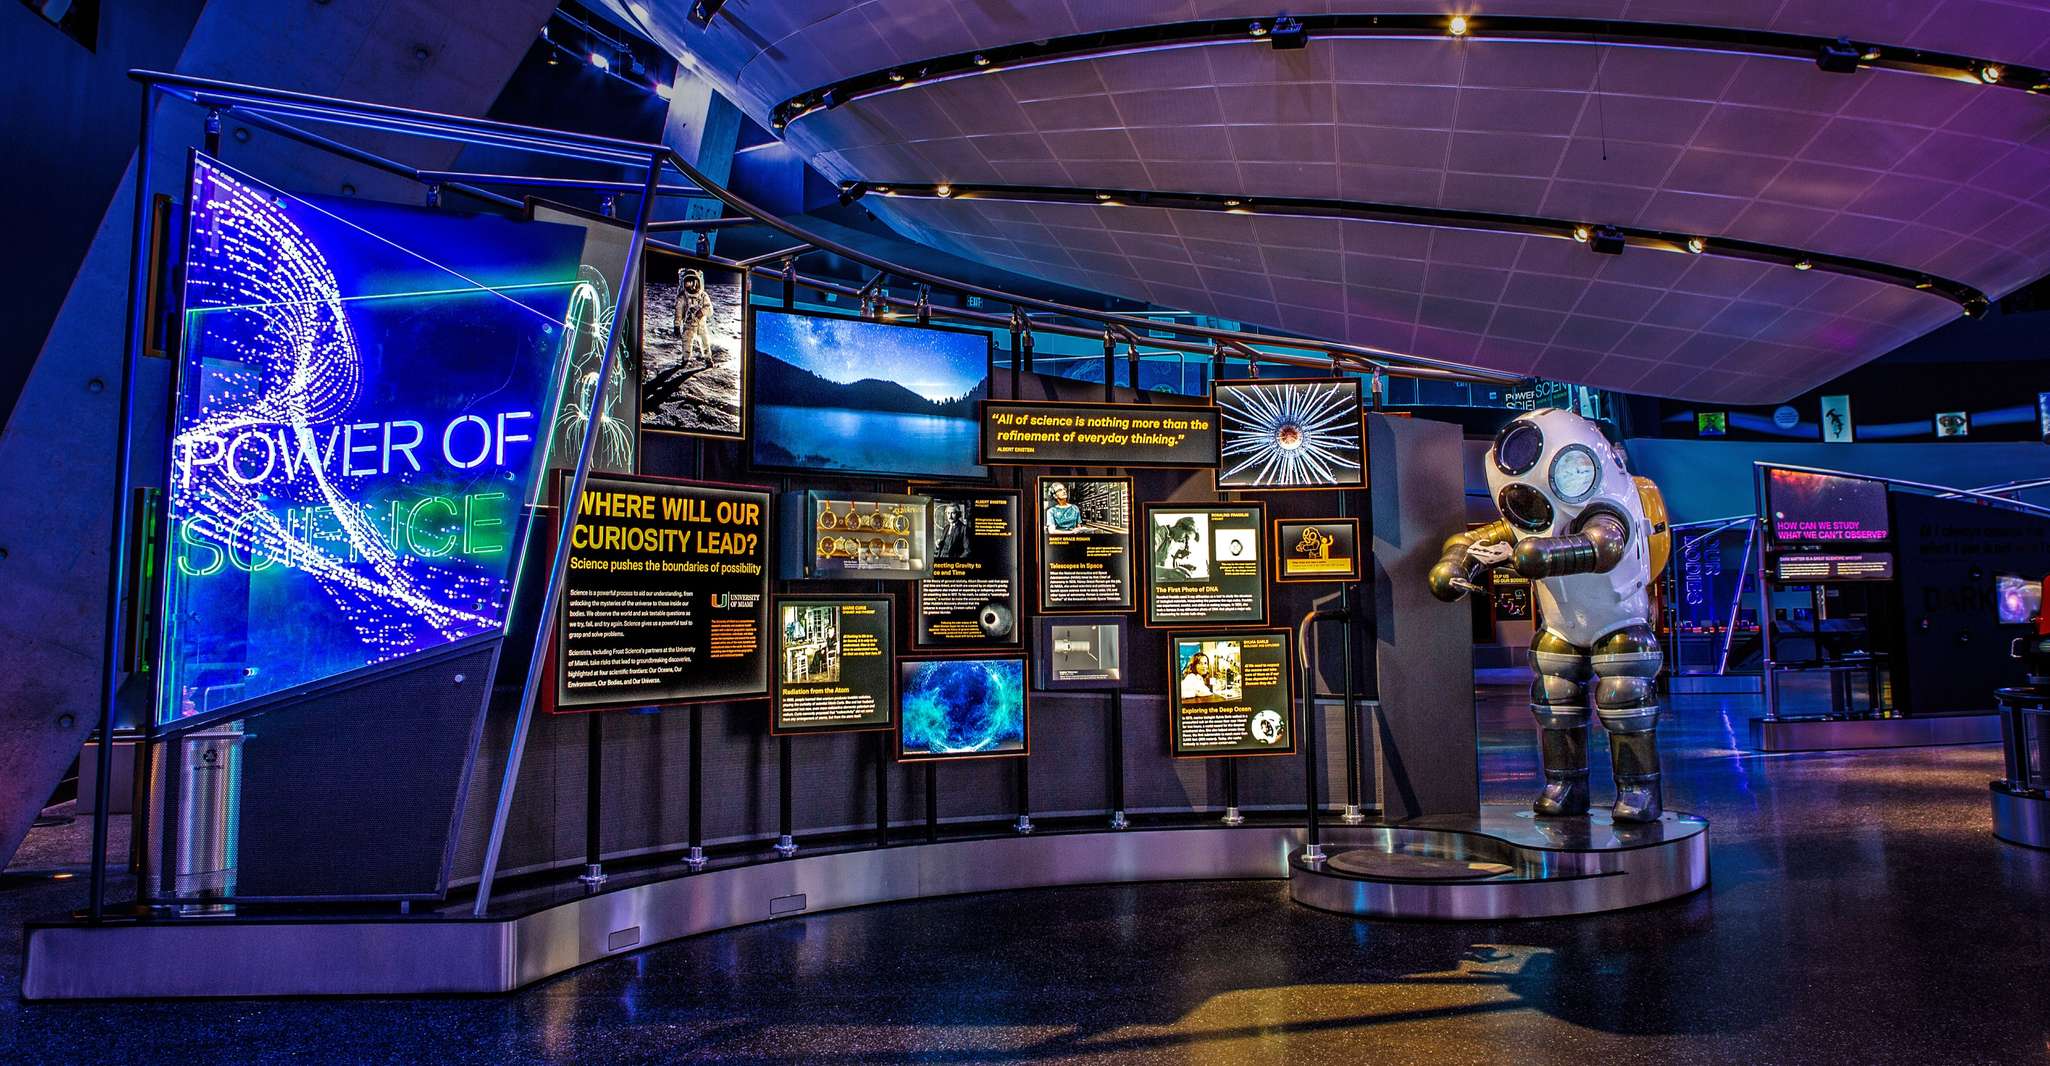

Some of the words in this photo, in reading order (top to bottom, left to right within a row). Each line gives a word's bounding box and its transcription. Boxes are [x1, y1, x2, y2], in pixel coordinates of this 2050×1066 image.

[1536, 381, 1567, 398] SCIEN
[1015, 414, 1028, 425] of
[1030, 414, 1072, 426] science
[1075, 416, 1085, 427] is
[1088, 416, 1129, 430] nothing
[1132, 420, 1160, 429] more
[1162, 418, 1188, 430] than
[1190, 419, 1208, 430] the
[997, 430, 1060, 442] refinement
[1062, 431, 1075, 442] of
[1078, 433, 1128, 445] everyday
[179, 420, 424, 488] POWER
[442, 410, 532, 469] OF
[578, 490, 655, 520] WHERE
[662, 496, 711, 523] WILL
[716, 501, 760, 526] OUR
[178, 493, 504, 576] SCIENCE
[1777, 521, 1797, 530] HOW
[1800, 521, 1816, 529] CAN
[1818, 521, 1832, 529] WE
[1833, 521, 1860, 529] STUDY
[572, 524, 691, 553] CURIOSITY
[697, 531, 758, 556] LEAD?
[570, 556, 608, 570] Science
[610, 558, 643, 572] pushes
[645, 560, 660, 571] the
[662, 560, 708, 573] boundaries
[710, 561, 720, 572] of
[721, 562, 761, 576] possibility
[711, 593, 727, 608] U
